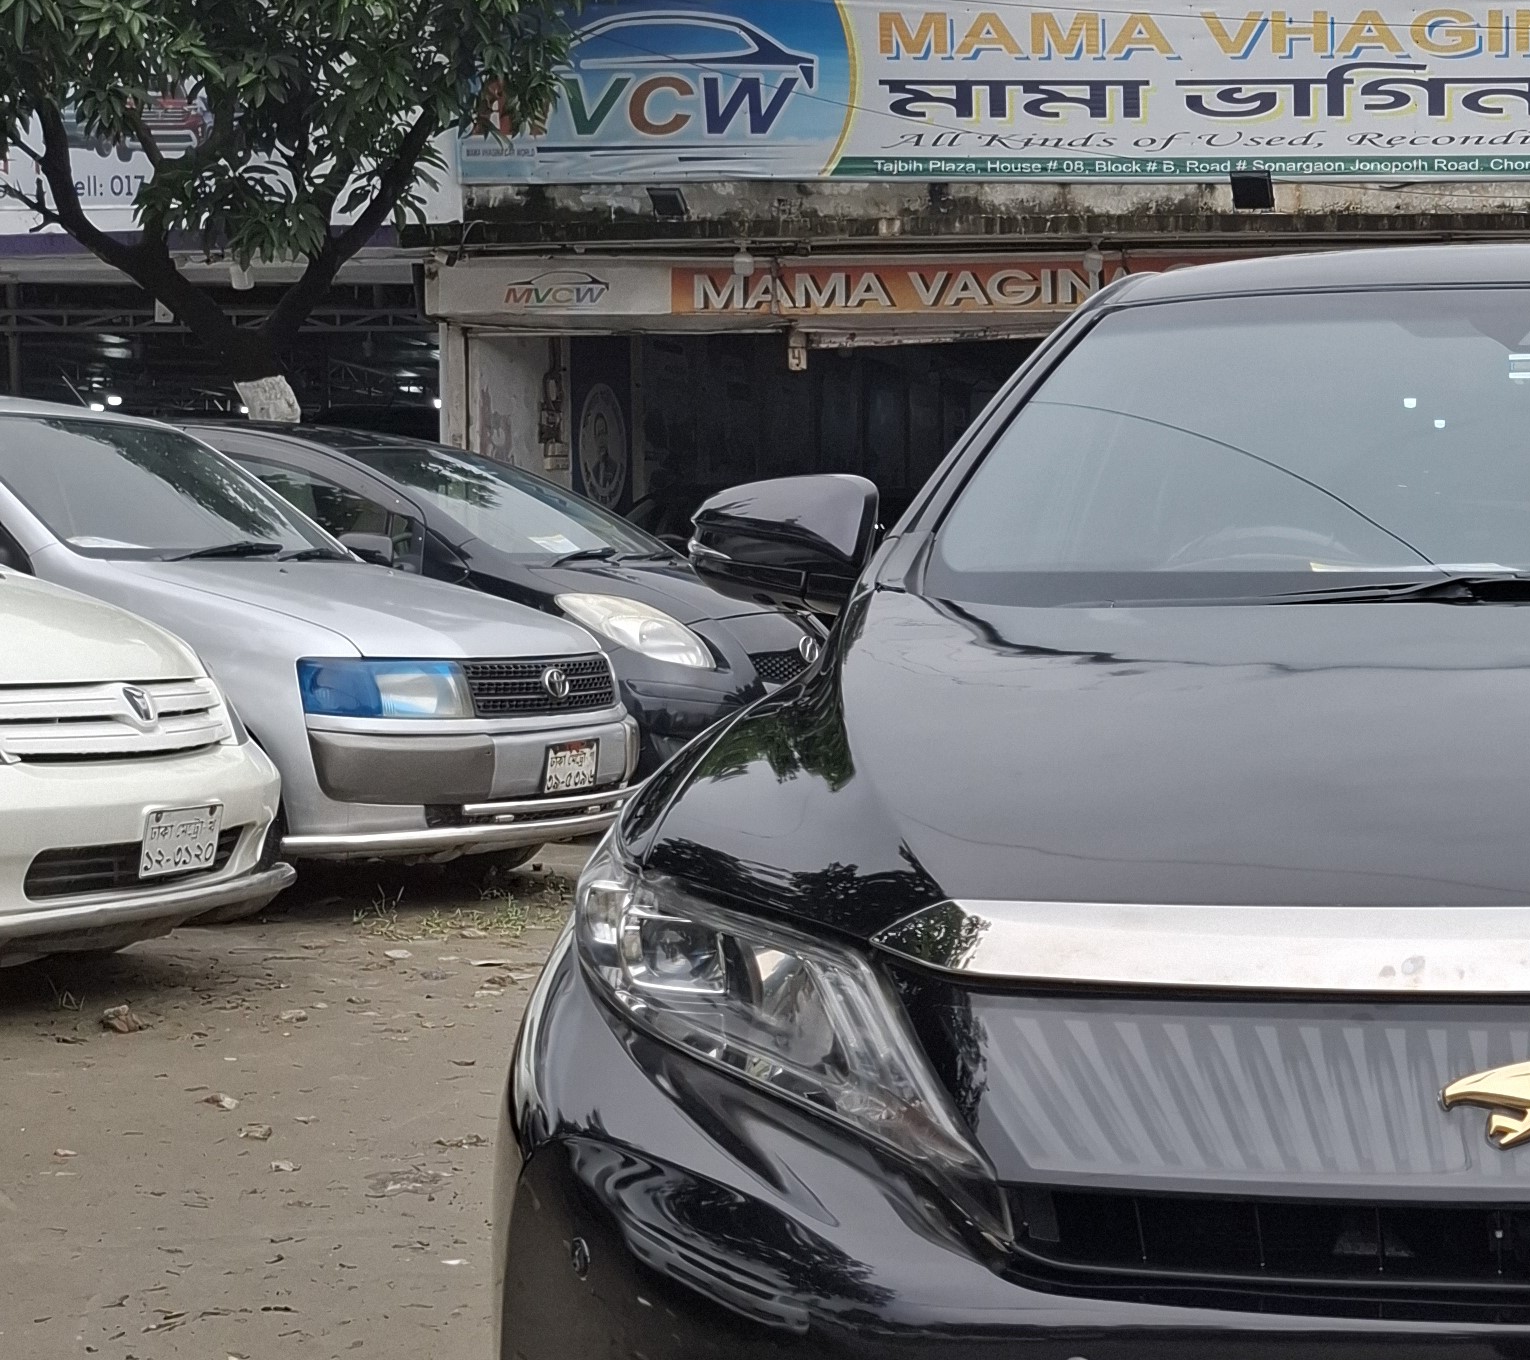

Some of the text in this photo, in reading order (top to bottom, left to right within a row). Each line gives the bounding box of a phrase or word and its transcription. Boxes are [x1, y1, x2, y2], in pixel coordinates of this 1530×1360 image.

[878, 11, 1180, 59] MAMA
[879, 79, 1150, 119] মামা
[881, 130, 963, 149] All
[976, 130, 1116, 149] Kinds
[1132, 130, 1191, 153] of
[1193, 130, 1327, 149] Used,
[874, 159, 923, 175] Tajbih
[929, 160, 981, 175] Plaza,
[987, 160, 1042, 173] House
[1046, 160, 1059, 173] #
[1063, 160, 1089, 175] 08,
[1095, 160, 1141, 173] Block
[1145, 160, 1158, 173] #
[1163, 160, 1180, 174] B,
[1186, 160, 1231, 172] Road
[1235, 159, 1248, 172] #
[1252, 158, 1345, 174] Sonargaon
[73, 175, 104, 197] ell:
[504, 287, 605, 304] MVCW
[693, 271, 894, 310] MAMA
[143, 842, 215, 872] ১২-৩১২০
